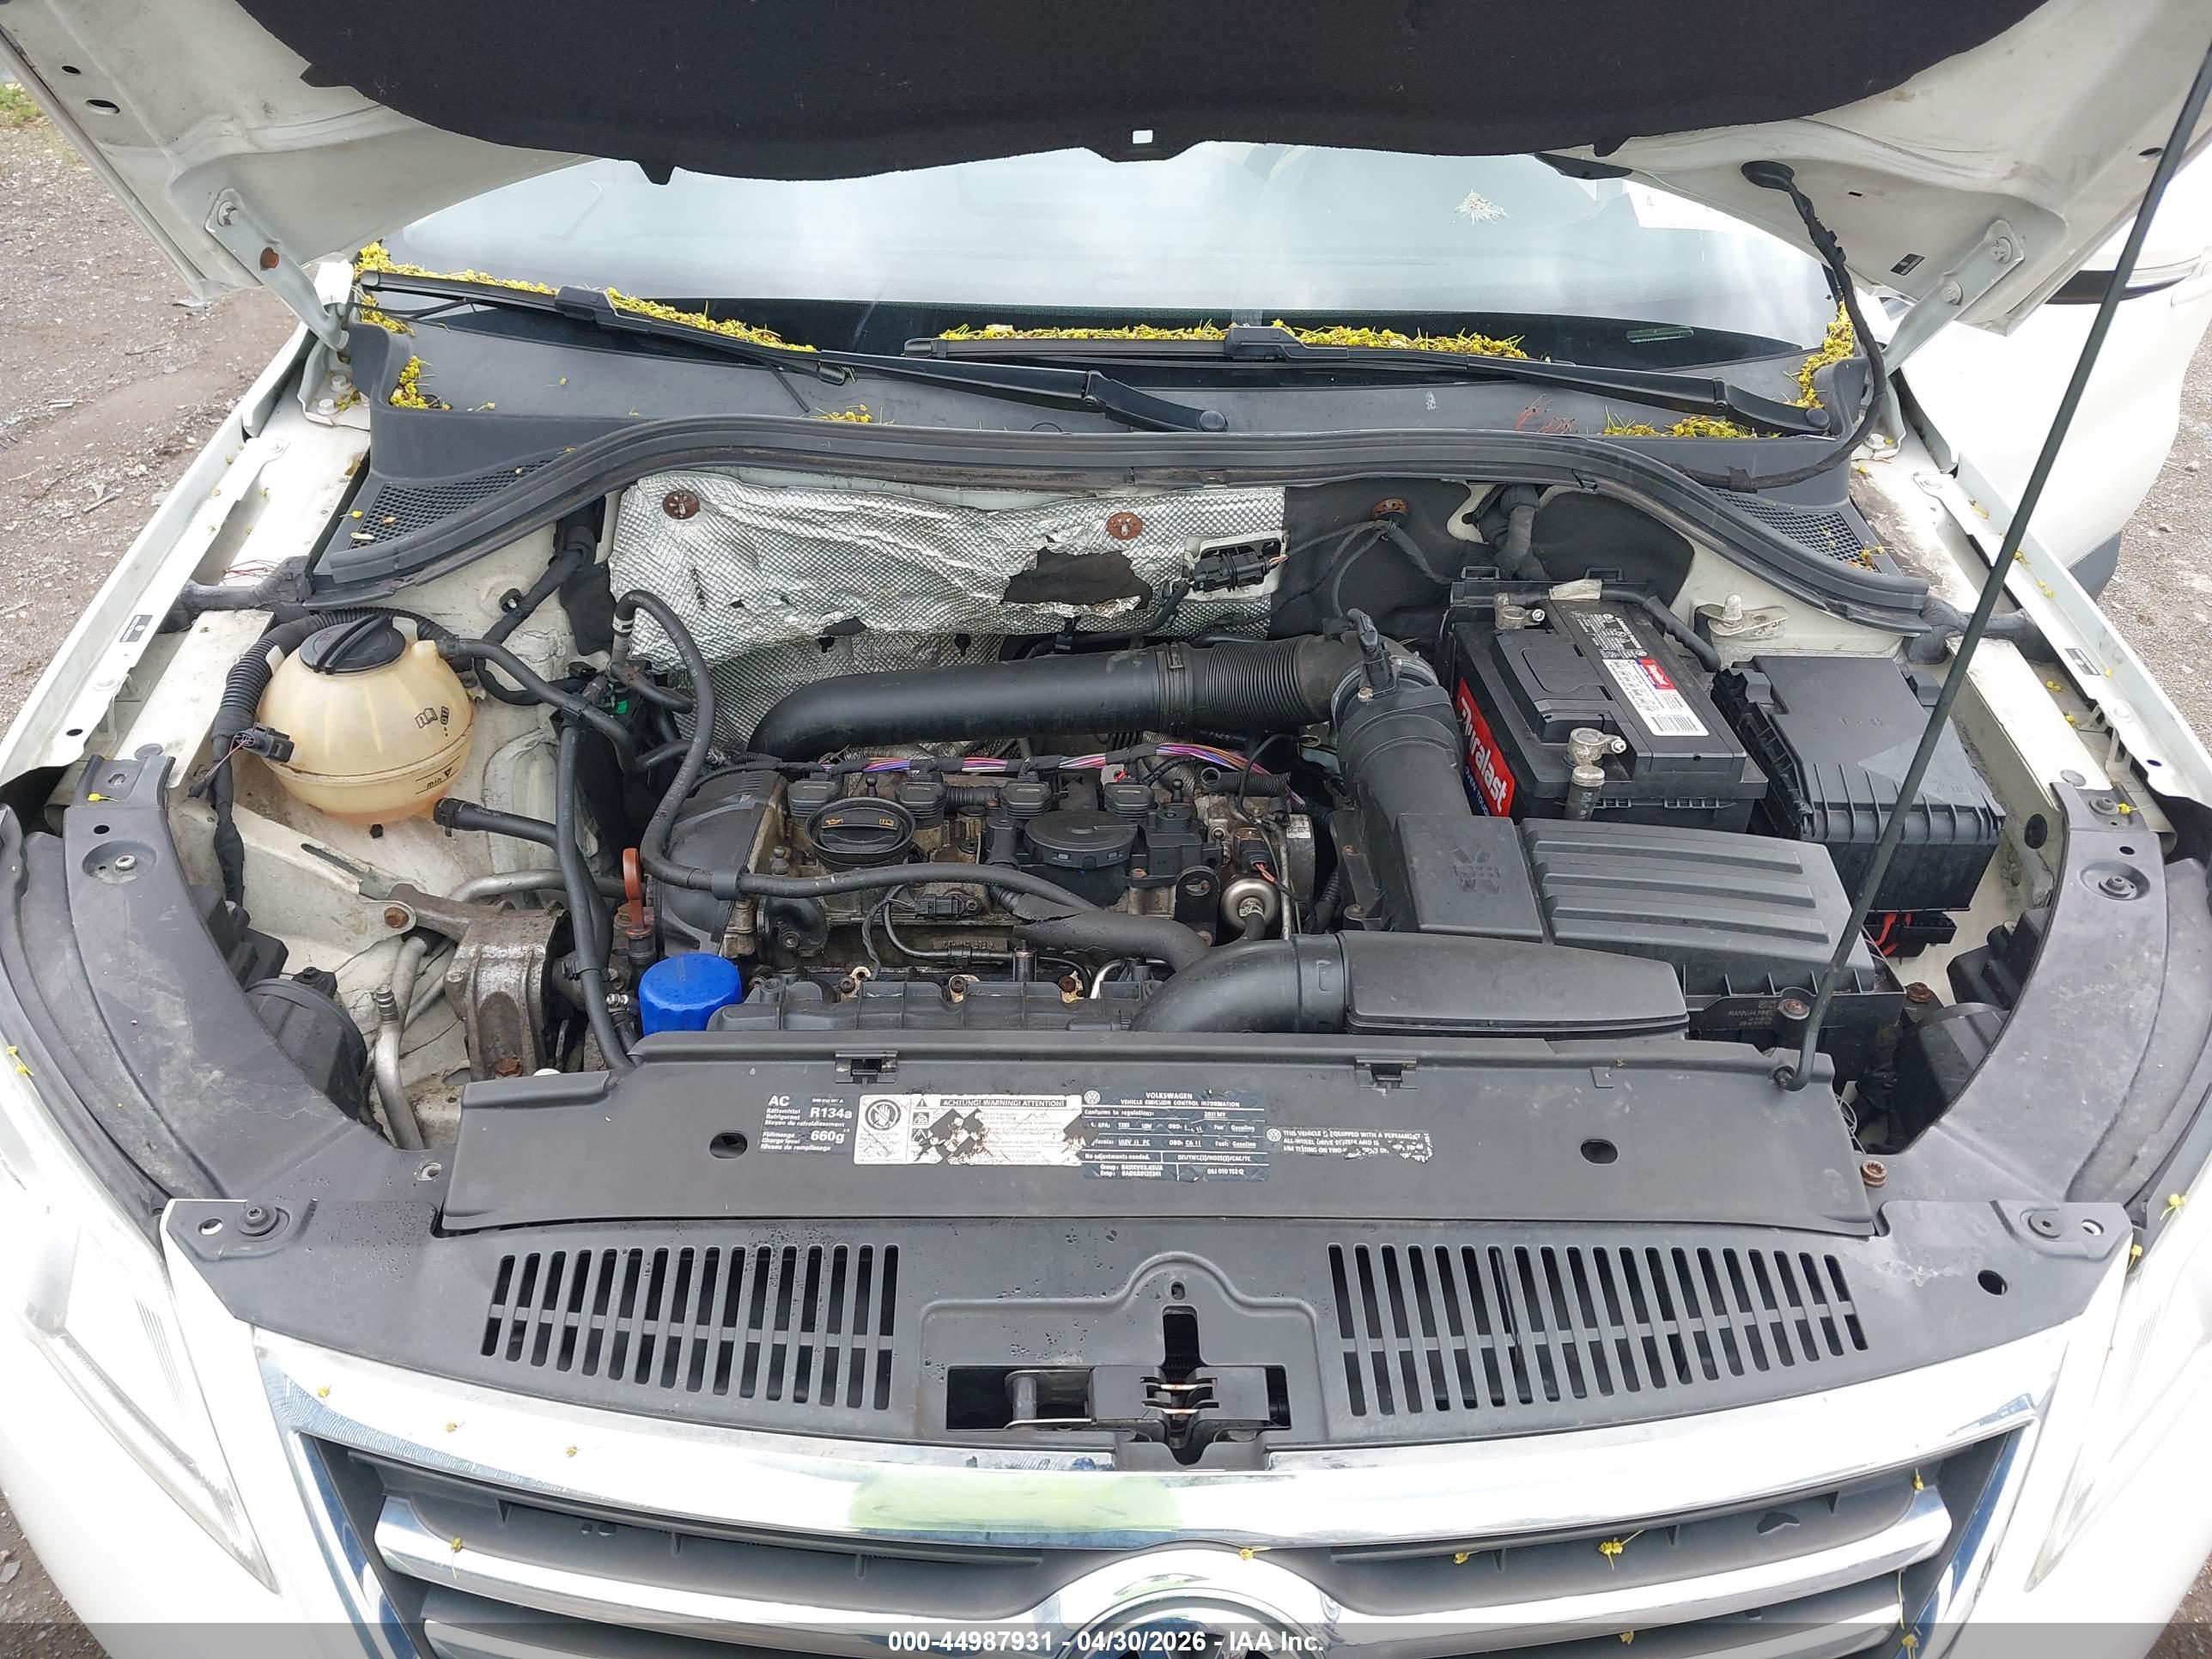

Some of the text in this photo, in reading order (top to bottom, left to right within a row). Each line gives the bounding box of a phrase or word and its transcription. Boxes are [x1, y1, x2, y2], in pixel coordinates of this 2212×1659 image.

[427, 777, 442, 789] min
[768, 1095, 790, 1107] AC
[810, 1107, 852, 1119] R134a
[811, 1130, 845, 1144] 660g
